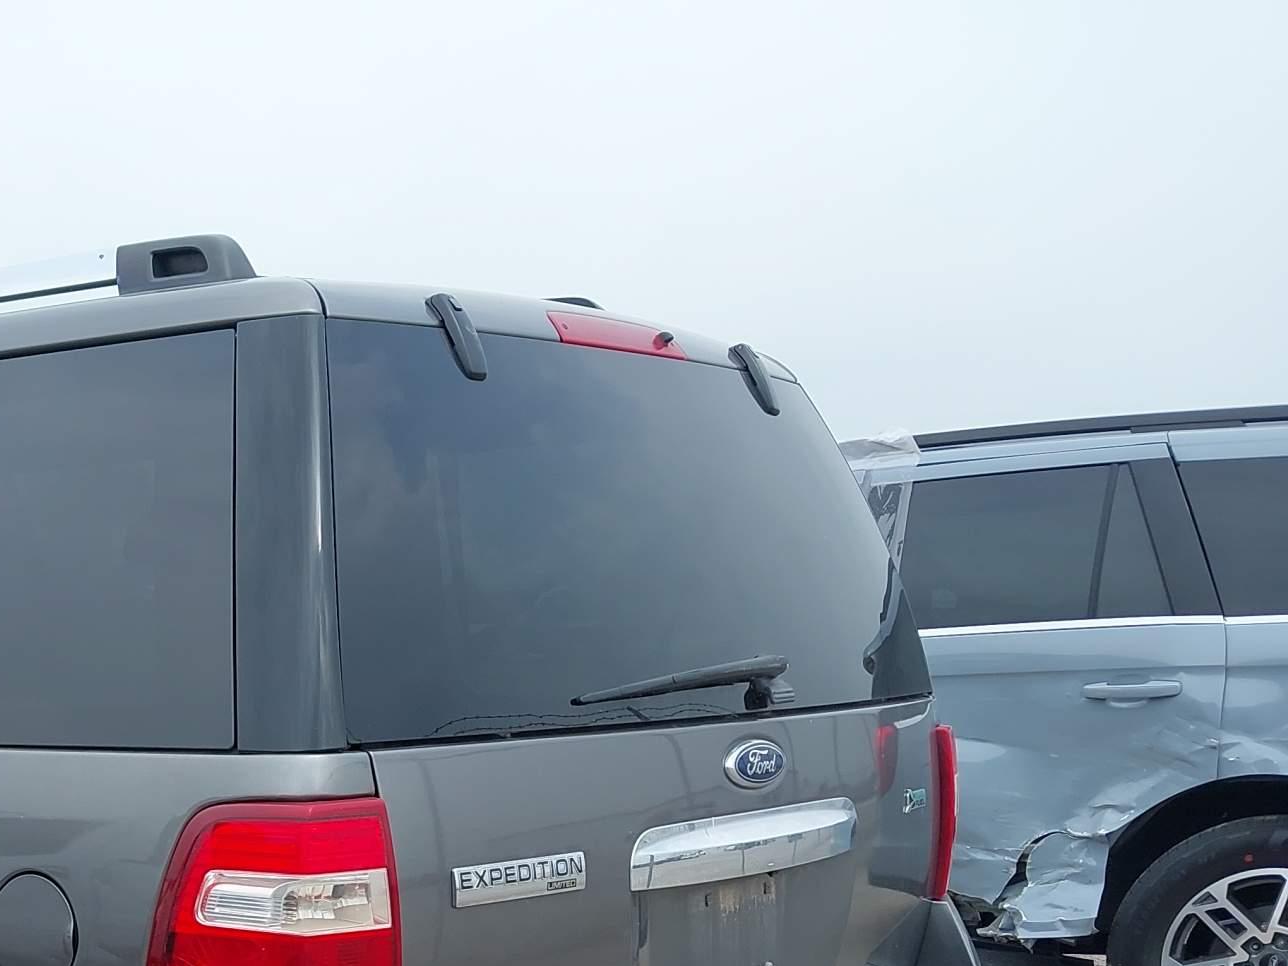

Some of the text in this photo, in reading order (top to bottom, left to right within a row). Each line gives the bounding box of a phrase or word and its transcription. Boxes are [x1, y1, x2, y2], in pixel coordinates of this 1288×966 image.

[746, 749, 777, 776] Ford
[459, 856, 584, 890] EXPEDITION
[547, 878, 577, 891] LIMITED
